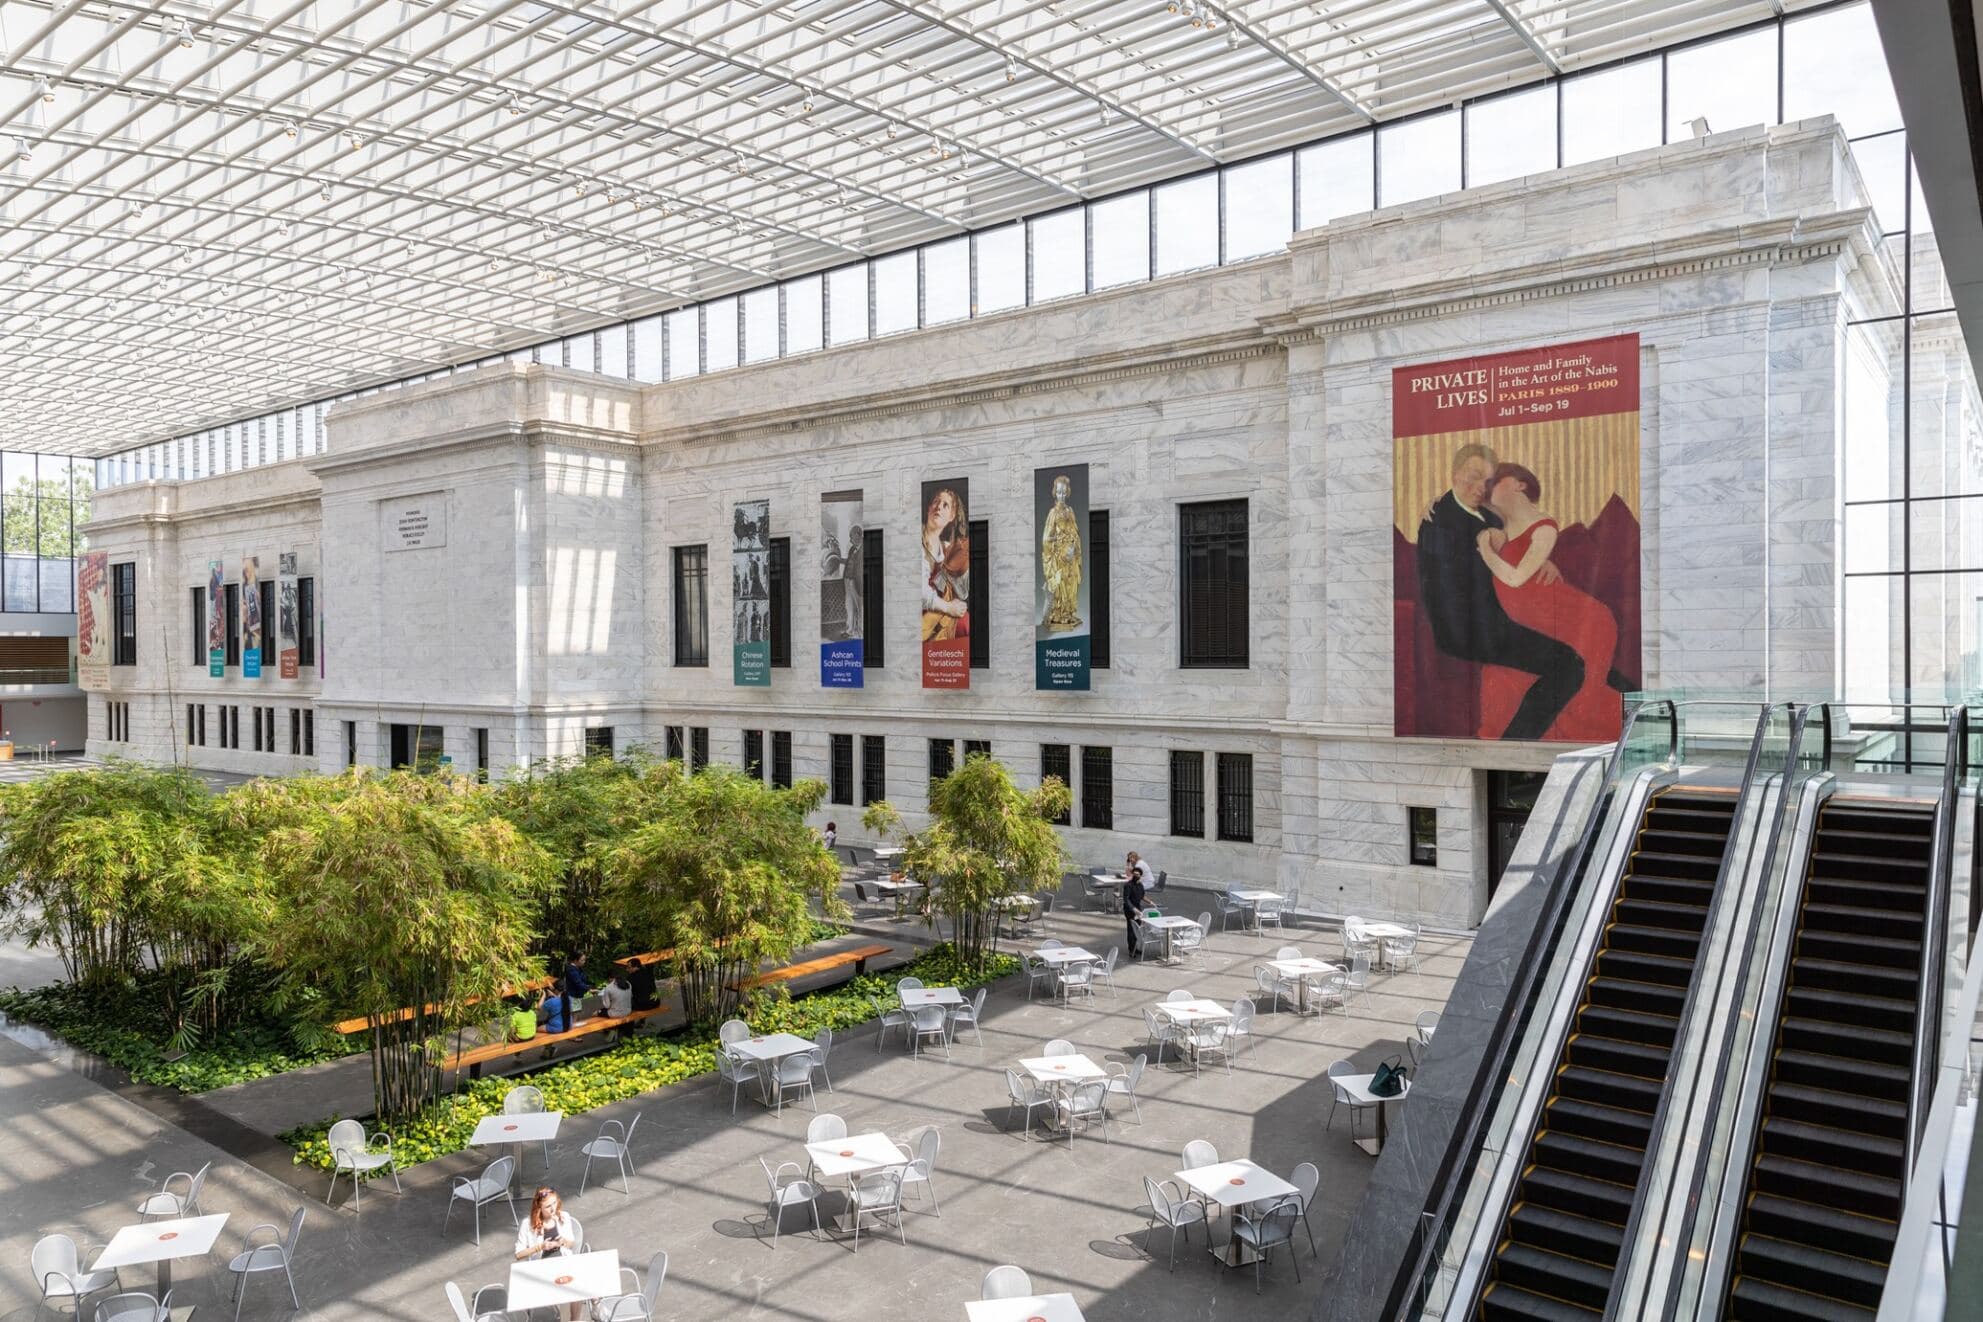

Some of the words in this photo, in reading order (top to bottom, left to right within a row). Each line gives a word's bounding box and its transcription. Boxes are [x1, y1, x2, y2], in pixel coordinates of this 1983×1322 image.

[1499, 366, 1530, 377] Home
[1533, 359, 1552, 371] and
[1556, 354, 1592, 368] Family
[1411, 369, 1487, 393] PRIVATE
[1499, 379, 1508, 388] in
[1511, 375, 1528, 386] the
[1531, 374, 1548, 384] Art
[1550, 370, 1563, 381] of
[1565, 368, 1582, 380] the
[1585, 363, 1618, 377] Nabis
[1436, 389, 1487, 409] LIVES
[1498, 388, 1545, 402] PARIS
[1498, 405, 1515, 417] Jul
[1556, 399, 1569, 410] 19
[742, 651, 763, 659] Chinese
[831, 651, 854, 659] Ashcan
[927, 649, 964, 658] Gentileschi
[1045, 649, 1080, 657] Medieval
[928, 659, 963, 667] Variations
[1044, 658, 1082, 667] Treasures
